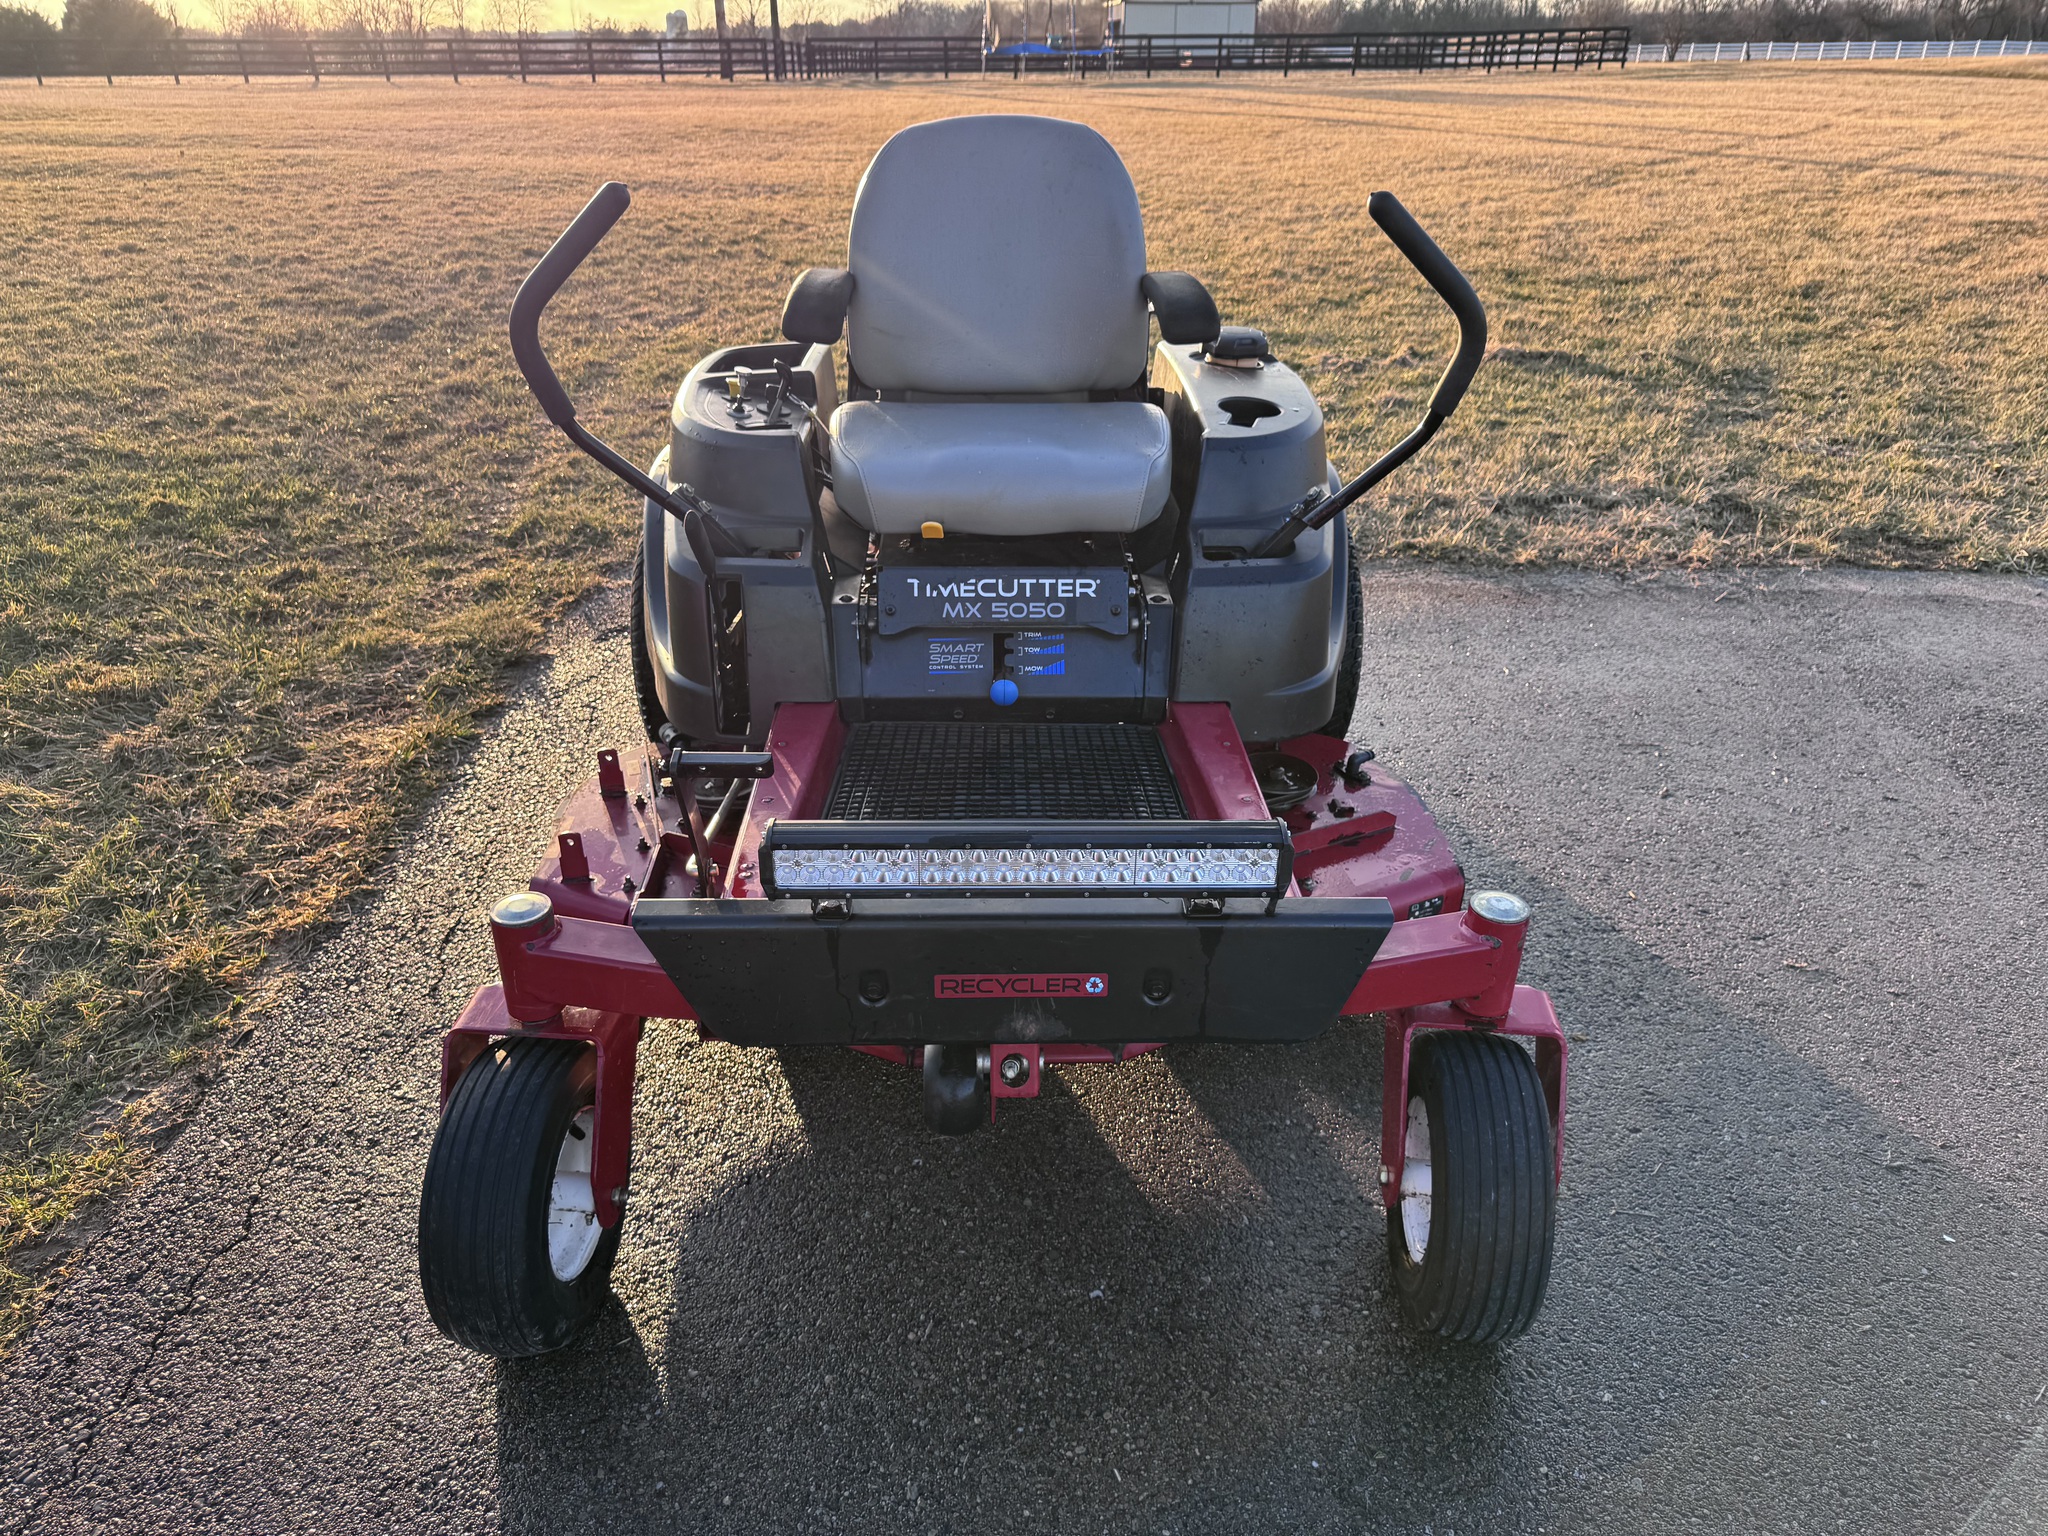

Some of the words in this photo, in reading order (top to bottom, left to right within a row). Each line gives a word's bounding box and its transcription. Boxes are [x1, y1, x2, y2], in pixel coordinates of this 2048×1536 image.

[942, 602, 982, 618] MX
[991, 602, 1065, 618] 5050
[929, 643, 985, 653] SMART
[929, 654, 979, 664] SPEED
[940, 978, 1081, 994] RECYCLER
